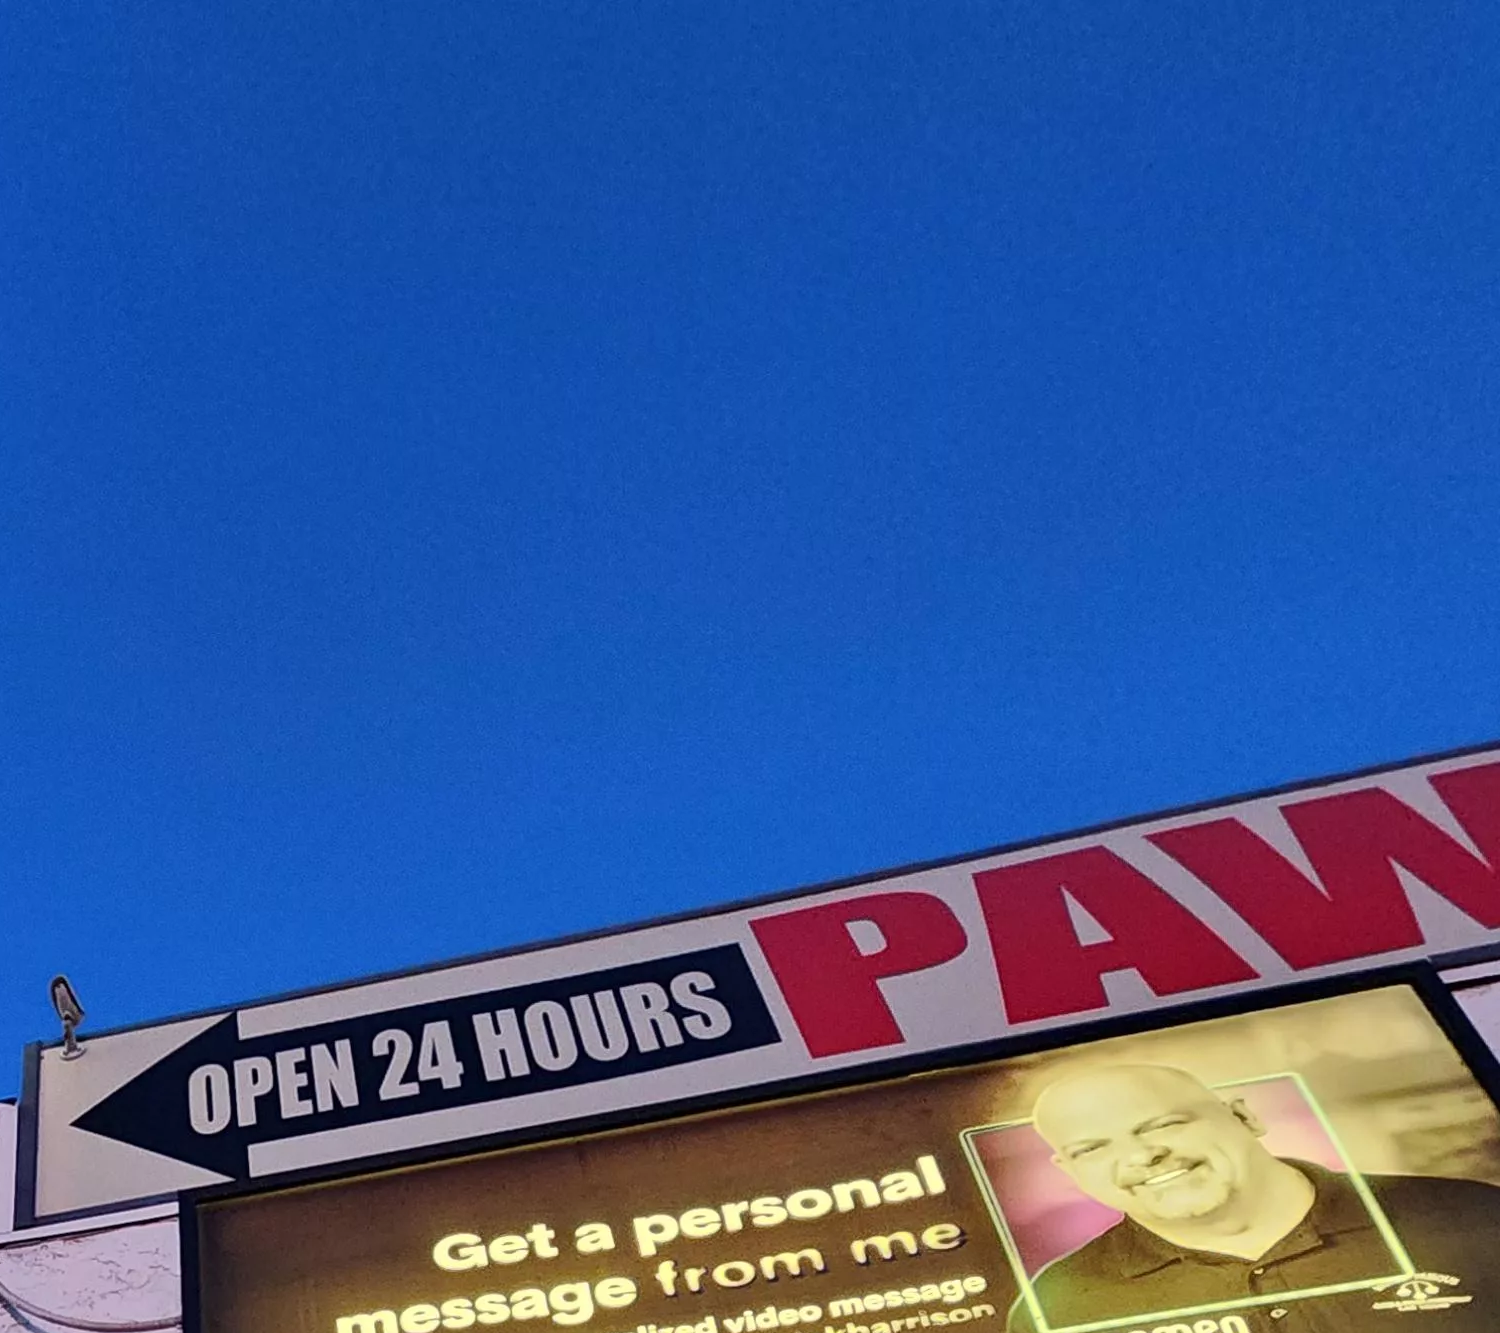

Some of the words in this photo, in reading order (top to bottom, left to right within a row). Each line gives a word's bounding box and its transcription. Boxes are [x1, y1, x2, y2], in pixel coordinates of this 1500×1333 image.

[187, 1038, 360, 1136] OPEN
[371, 1020, 466, 1102] 24
[472, 972, 734, 1081] HOURS
[433, 1222, 559, 1272] Get
[575, 1220, 615, 1254] a
[633, 1155, 947, 1258] personal
[656, 1247, 827, 1297] from
[850, 1223, 967, 1265] me
[829, 1275, 988, 1318] message
